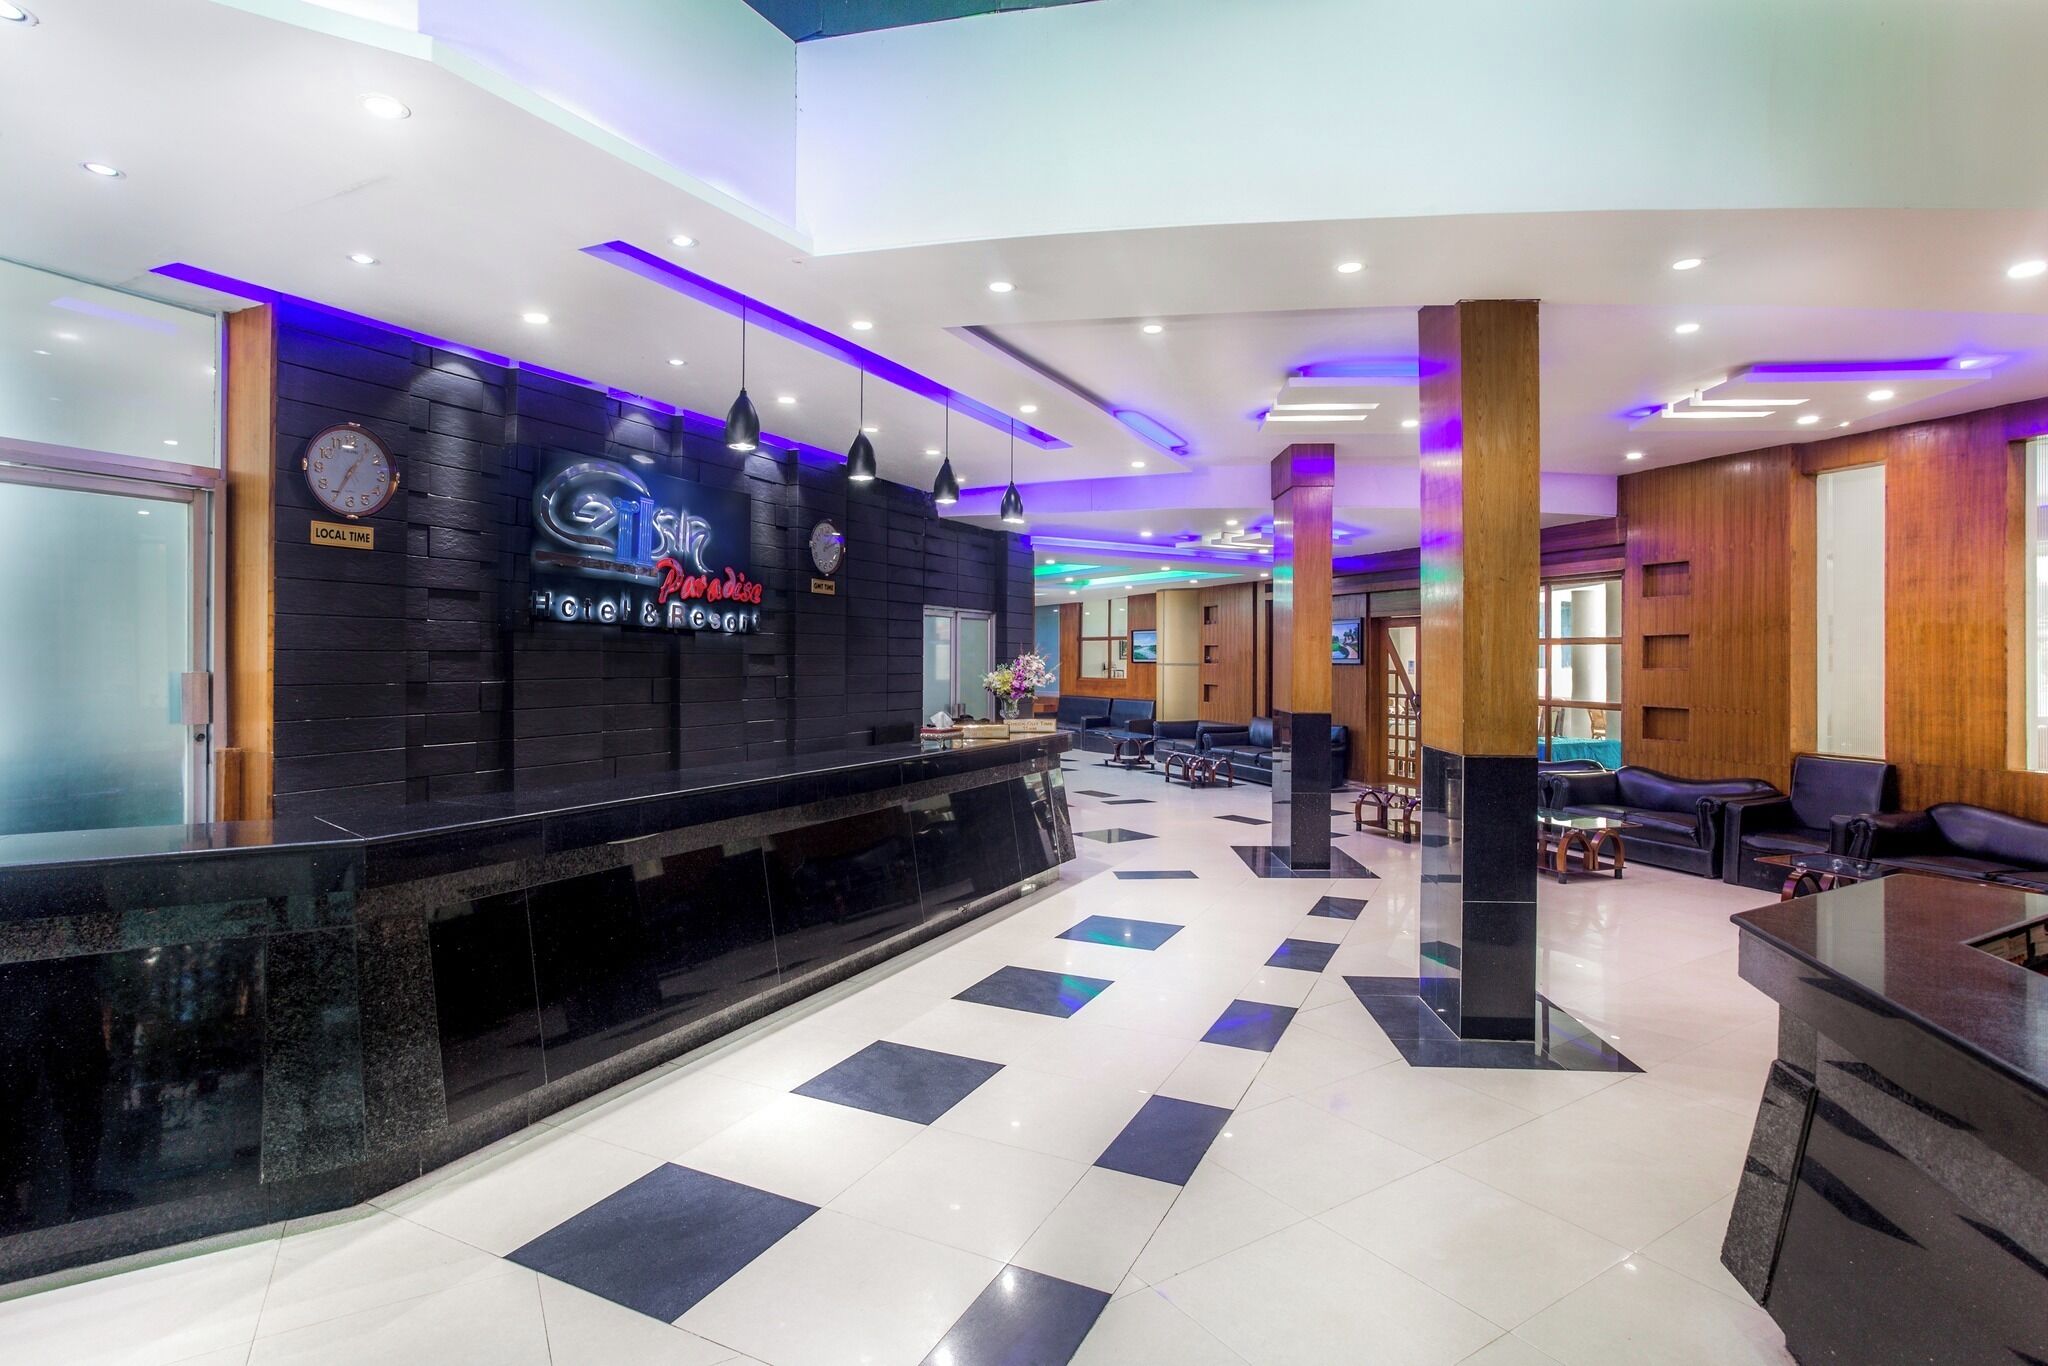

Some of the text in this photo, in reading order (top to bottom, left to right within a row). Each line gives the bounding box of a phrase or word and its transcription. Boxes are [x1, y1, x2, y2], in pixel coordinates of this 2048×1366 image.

[320, 446, 334, 460] 10
[319, 478, 328, 489] 8
[316, 528, 370, 543] LOCAL TIME
[655, 557, 763, 604] Paradise
[814, 582, 824, 590] GMT
[531, 589, 762, 634] Hotel & Resort
